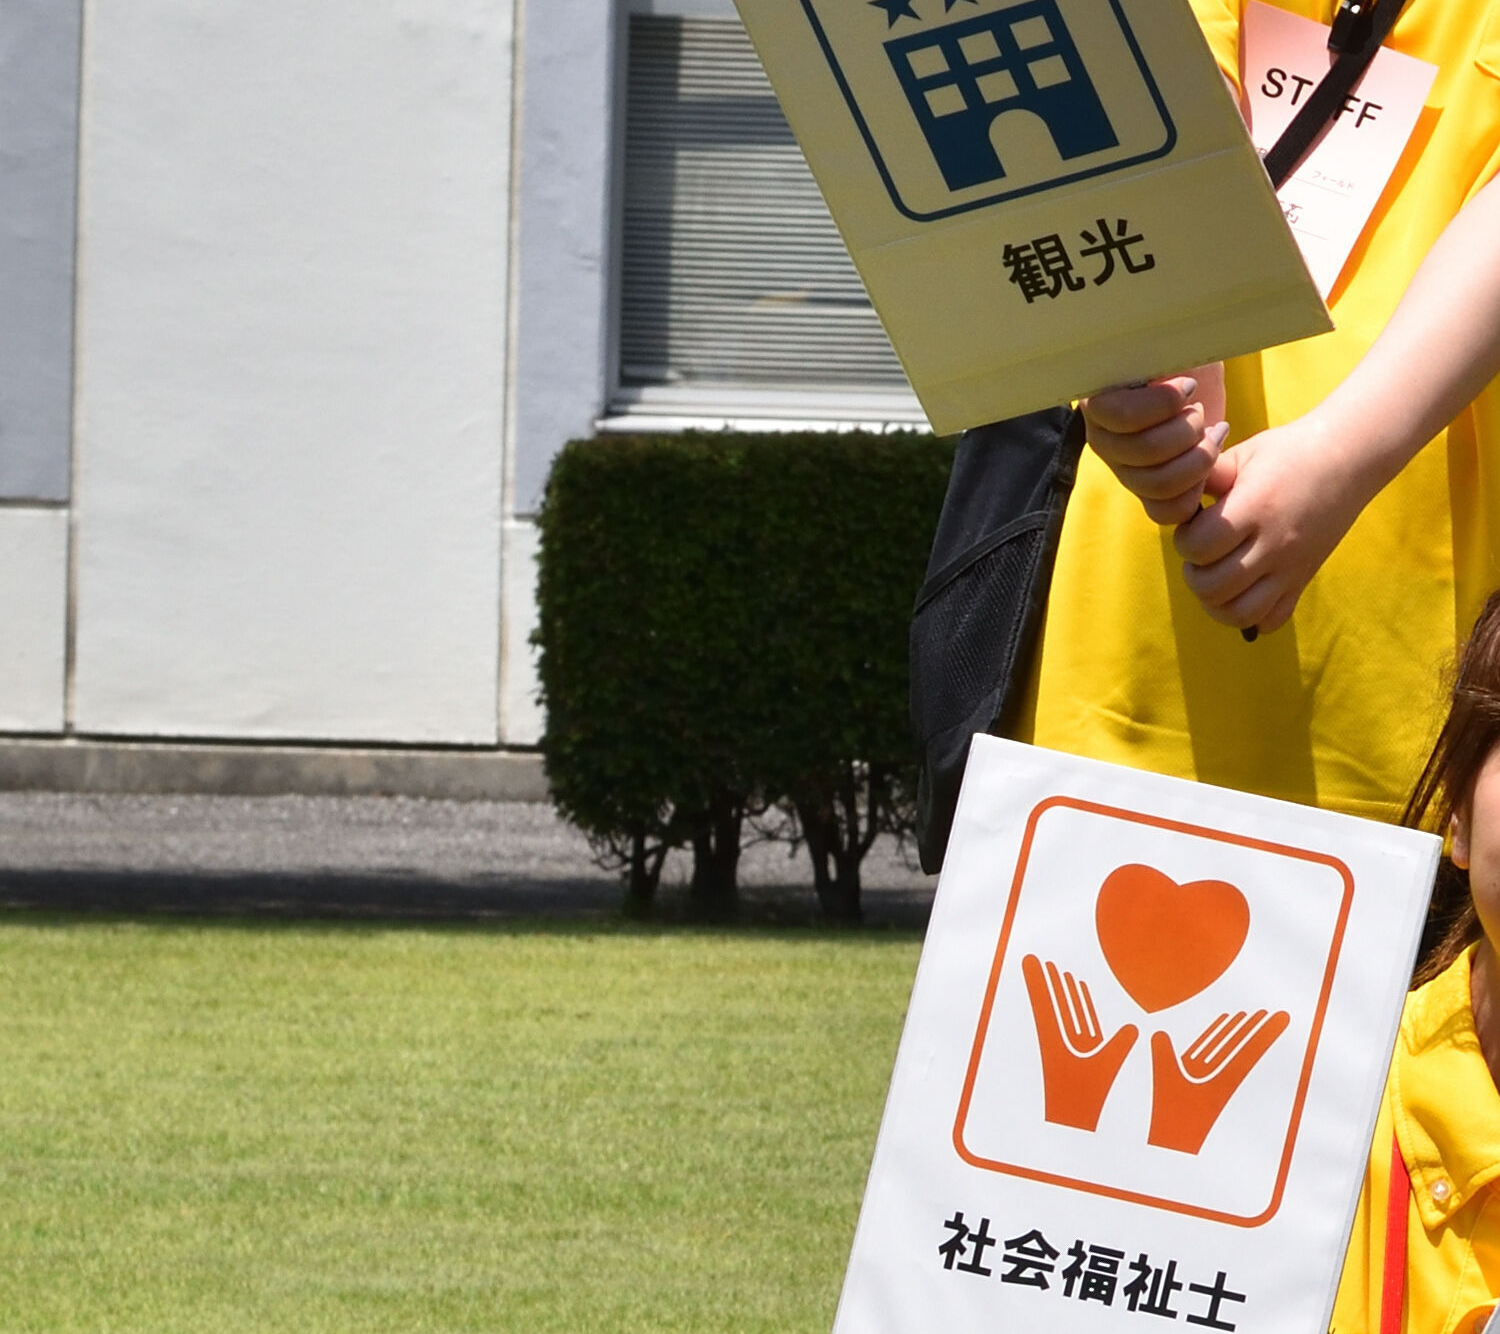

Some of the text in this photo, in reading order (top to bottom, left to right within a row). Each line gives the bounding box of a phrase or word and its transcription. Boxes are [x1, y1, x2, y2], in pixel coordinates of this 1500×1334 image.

[1261, 67, 1383, 128] STFF
[1002, 218, 1156, 304] 観光
[938, 1211, 1246, 1332] 社会福祉士
